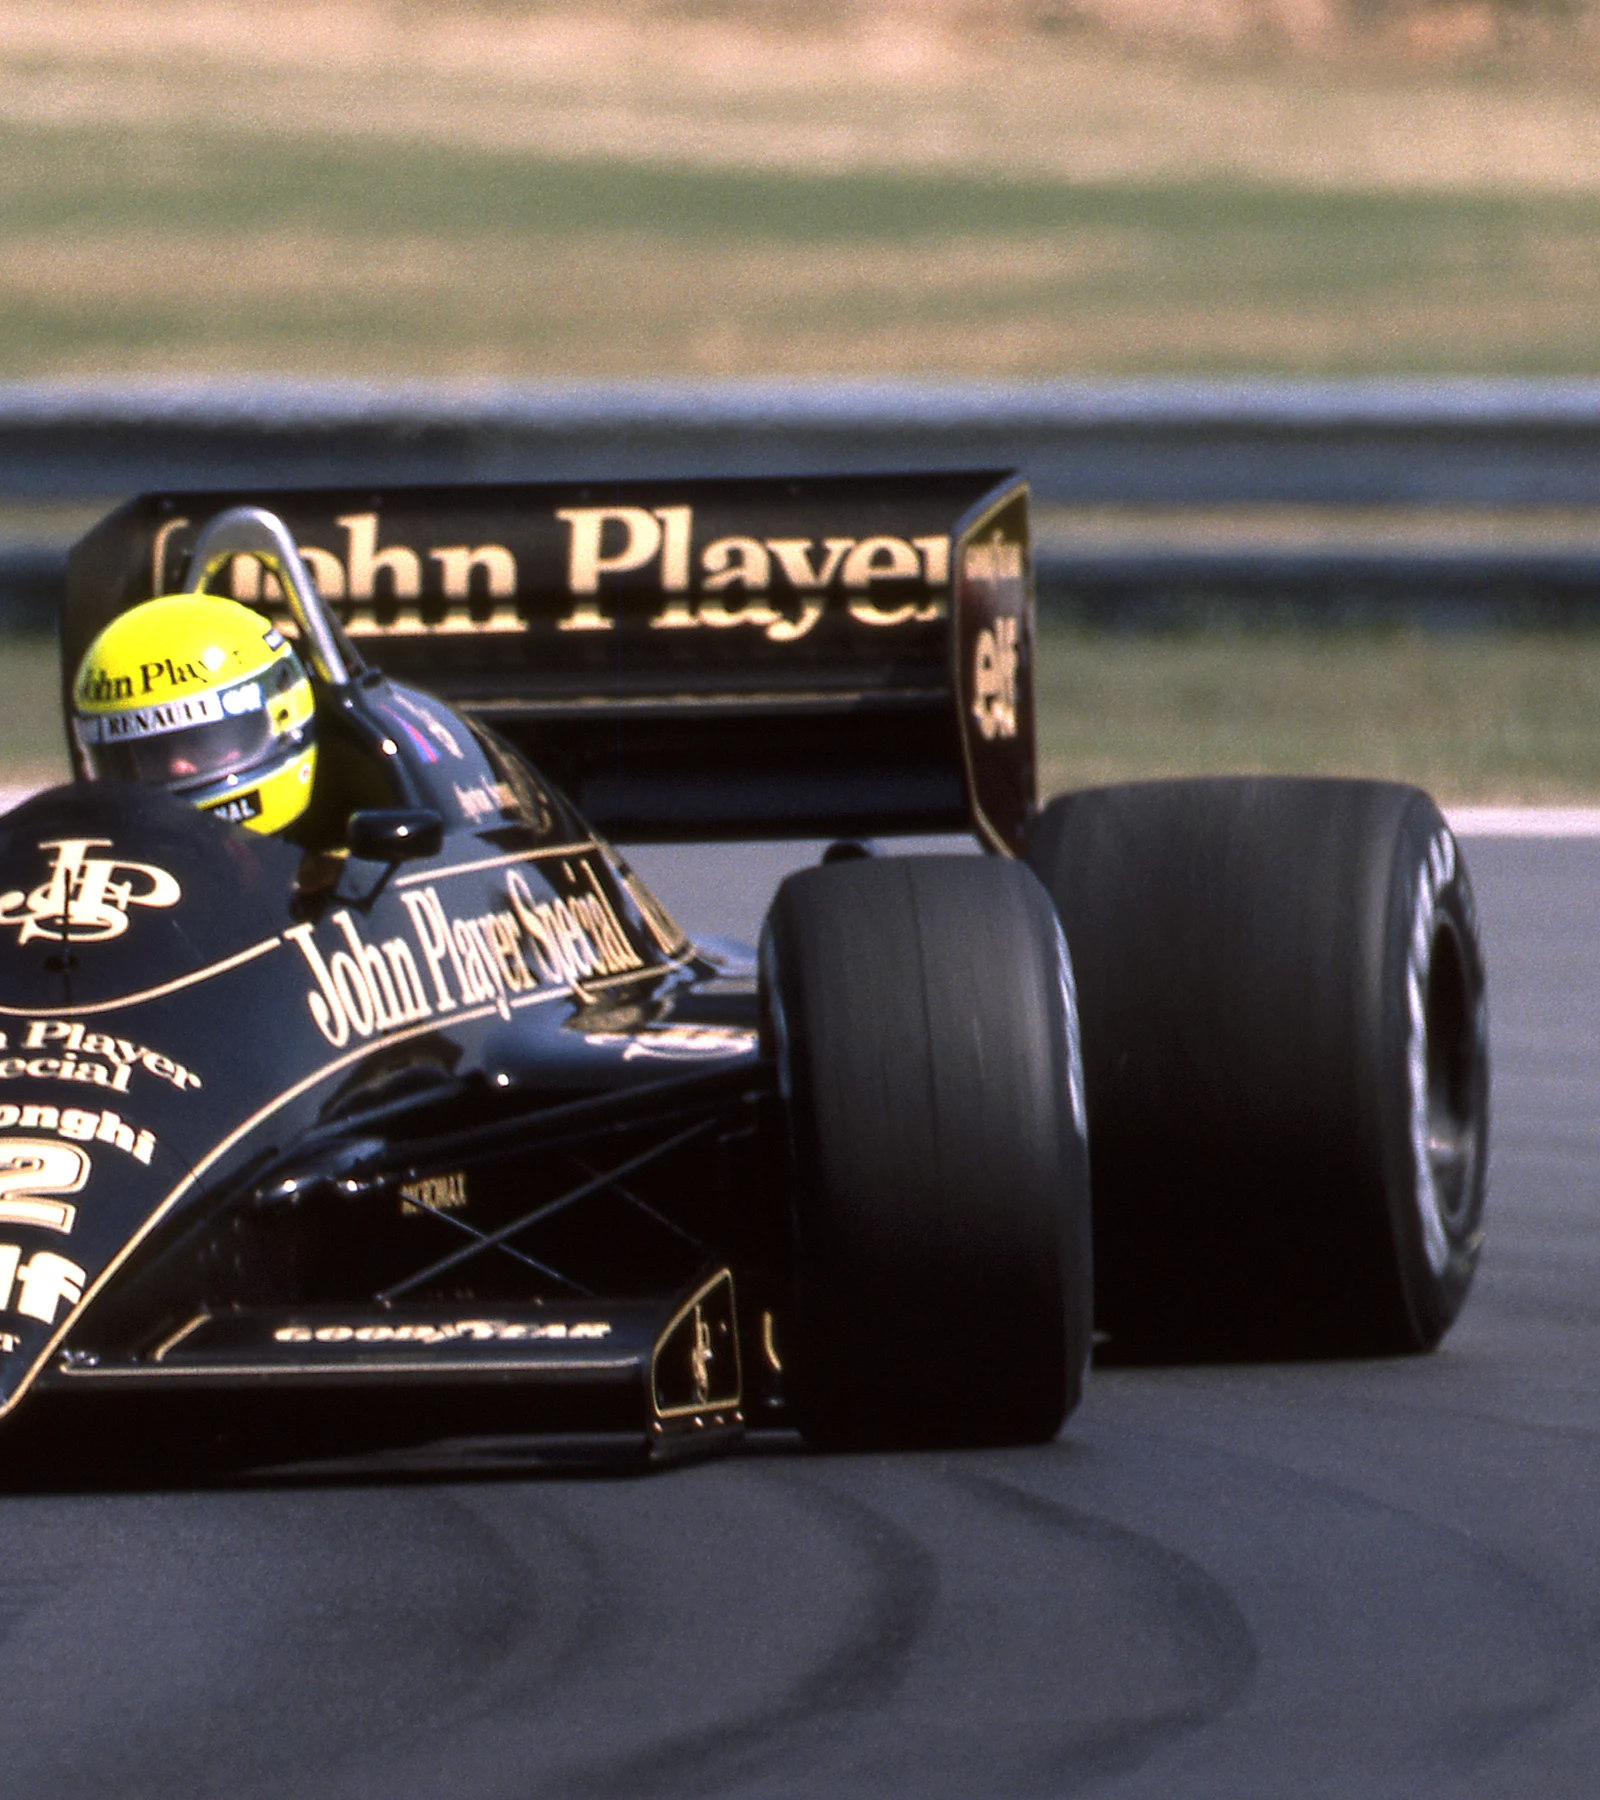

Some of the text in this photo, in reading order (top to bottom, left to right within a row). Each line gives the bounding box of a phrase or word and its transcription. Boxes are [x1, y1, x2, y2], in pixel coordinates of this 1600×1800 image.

[556, 505, 950, 641] Player
[284, 859, 644, 1048] John Player Special
[21, 1020, 203, 1092] Player
